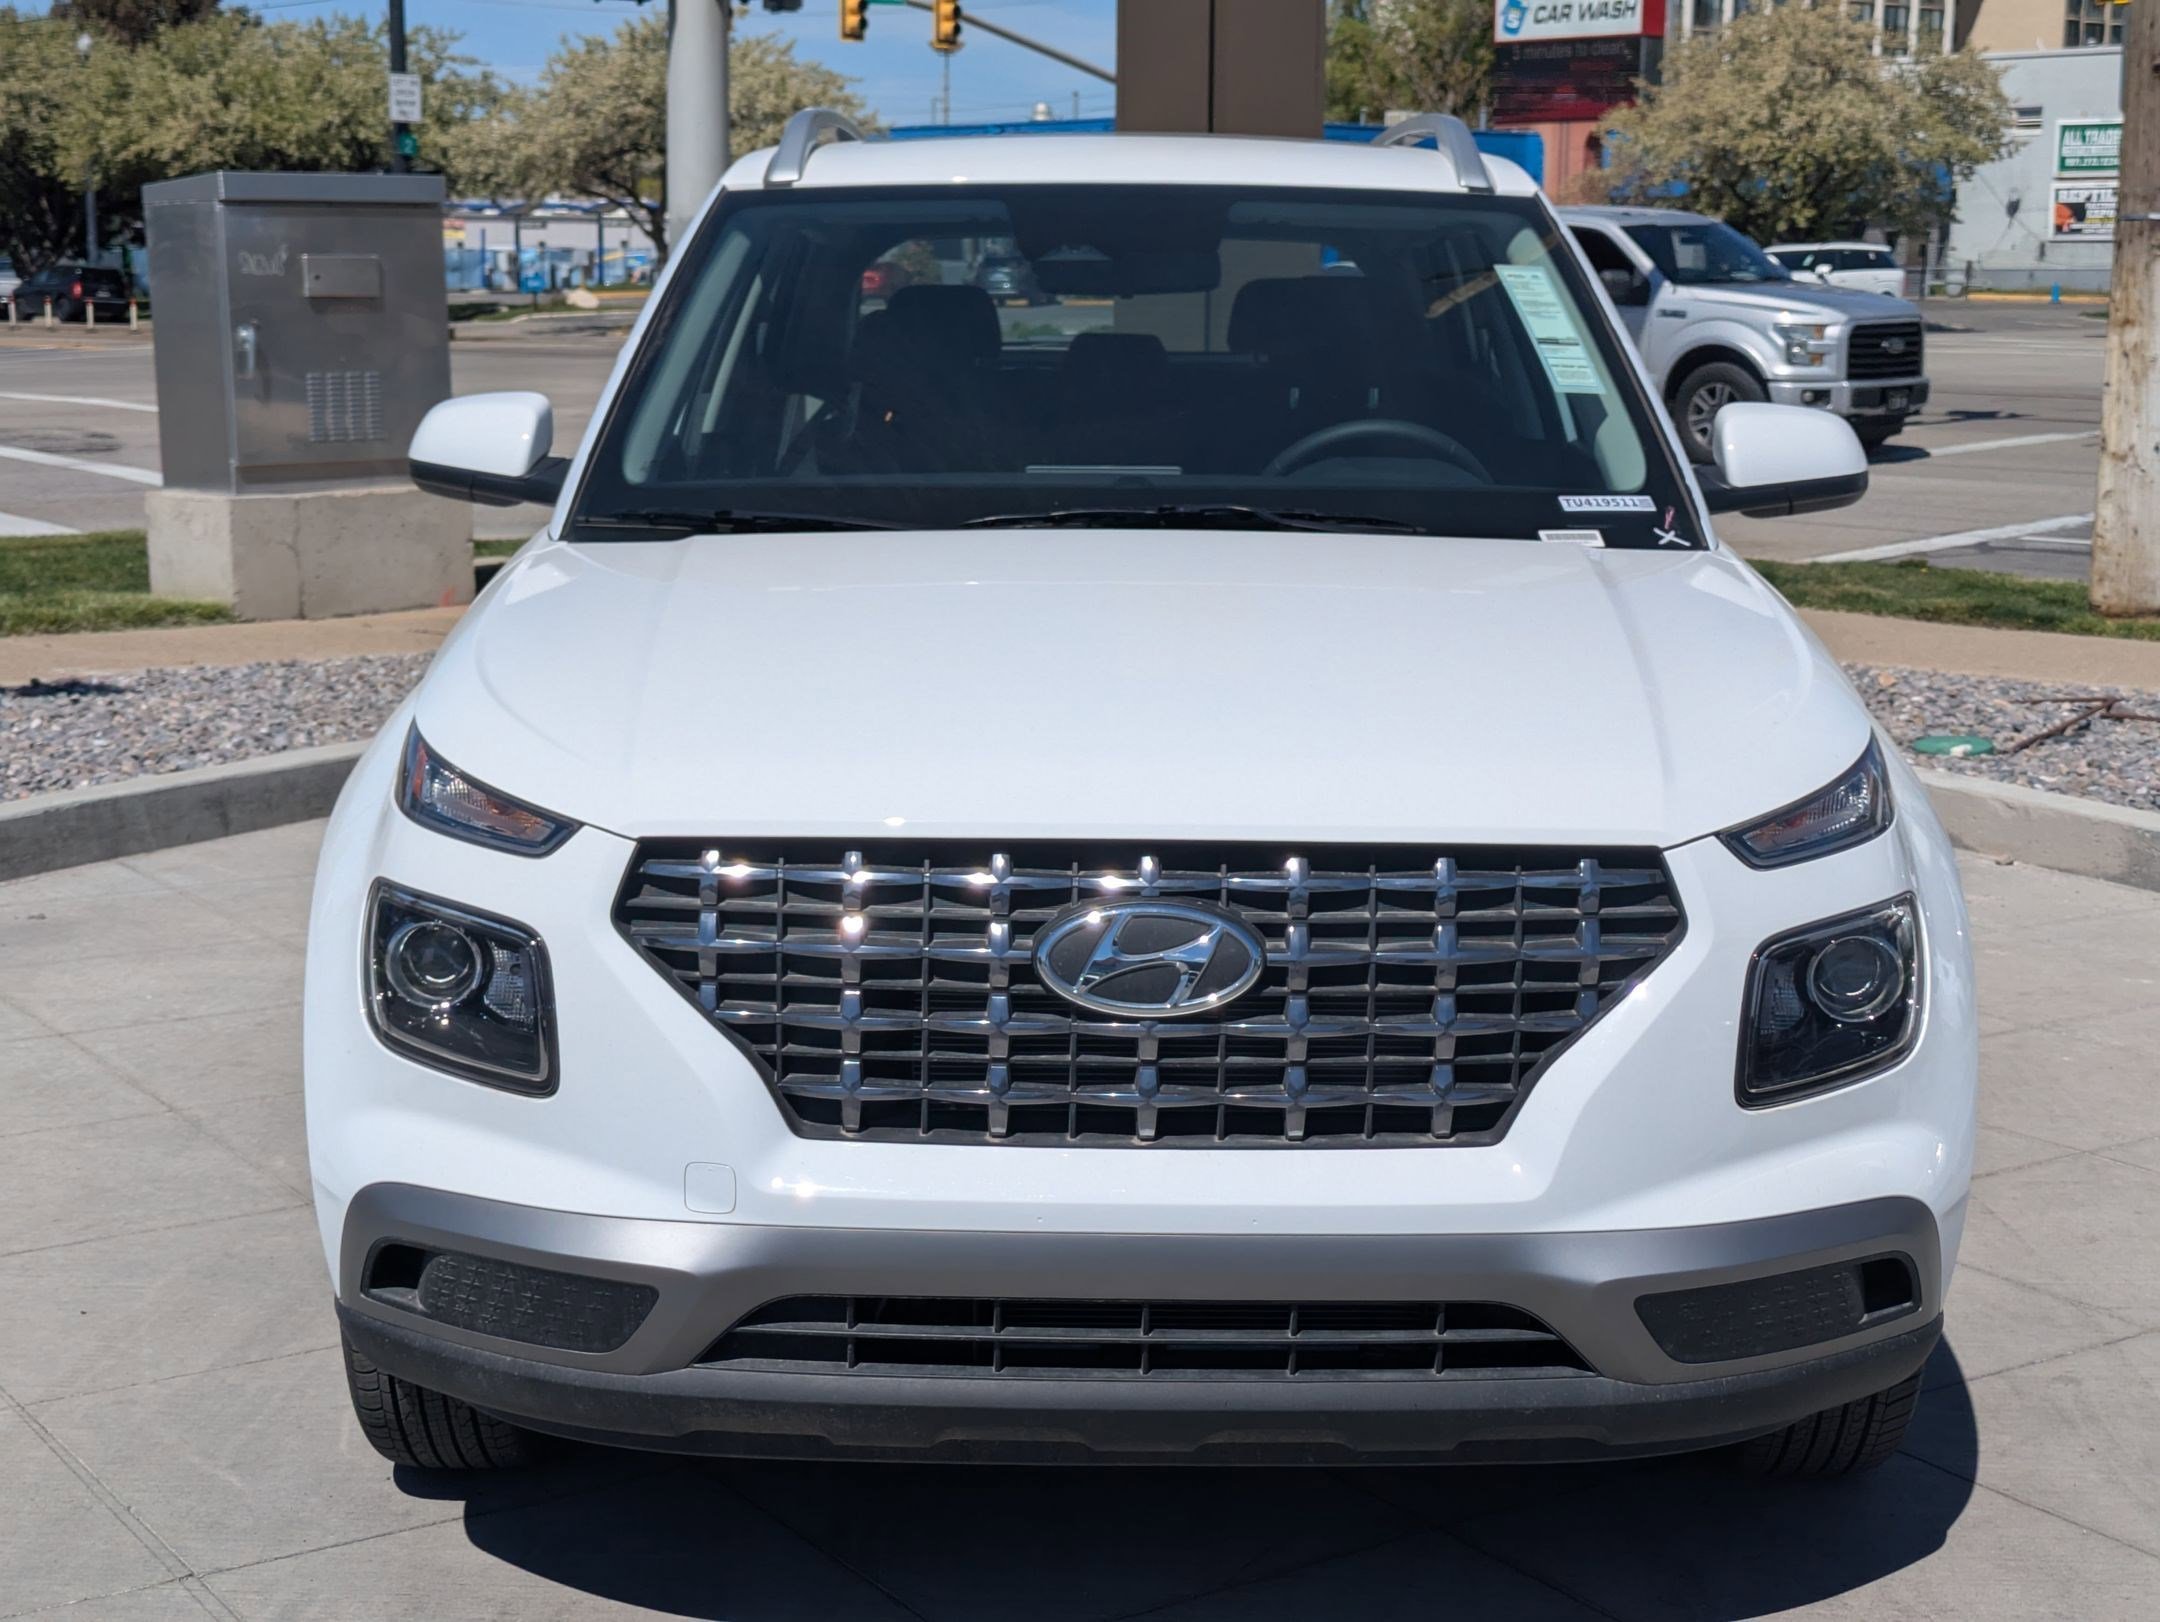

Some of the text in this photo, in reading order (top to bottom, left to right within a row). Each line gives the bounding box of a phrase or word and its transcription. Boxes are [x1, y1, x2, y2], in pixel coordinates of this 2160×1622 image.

[1533, 1, 1637, 25] CAR WASH
[2063, 128, 2084, 146] ALL
